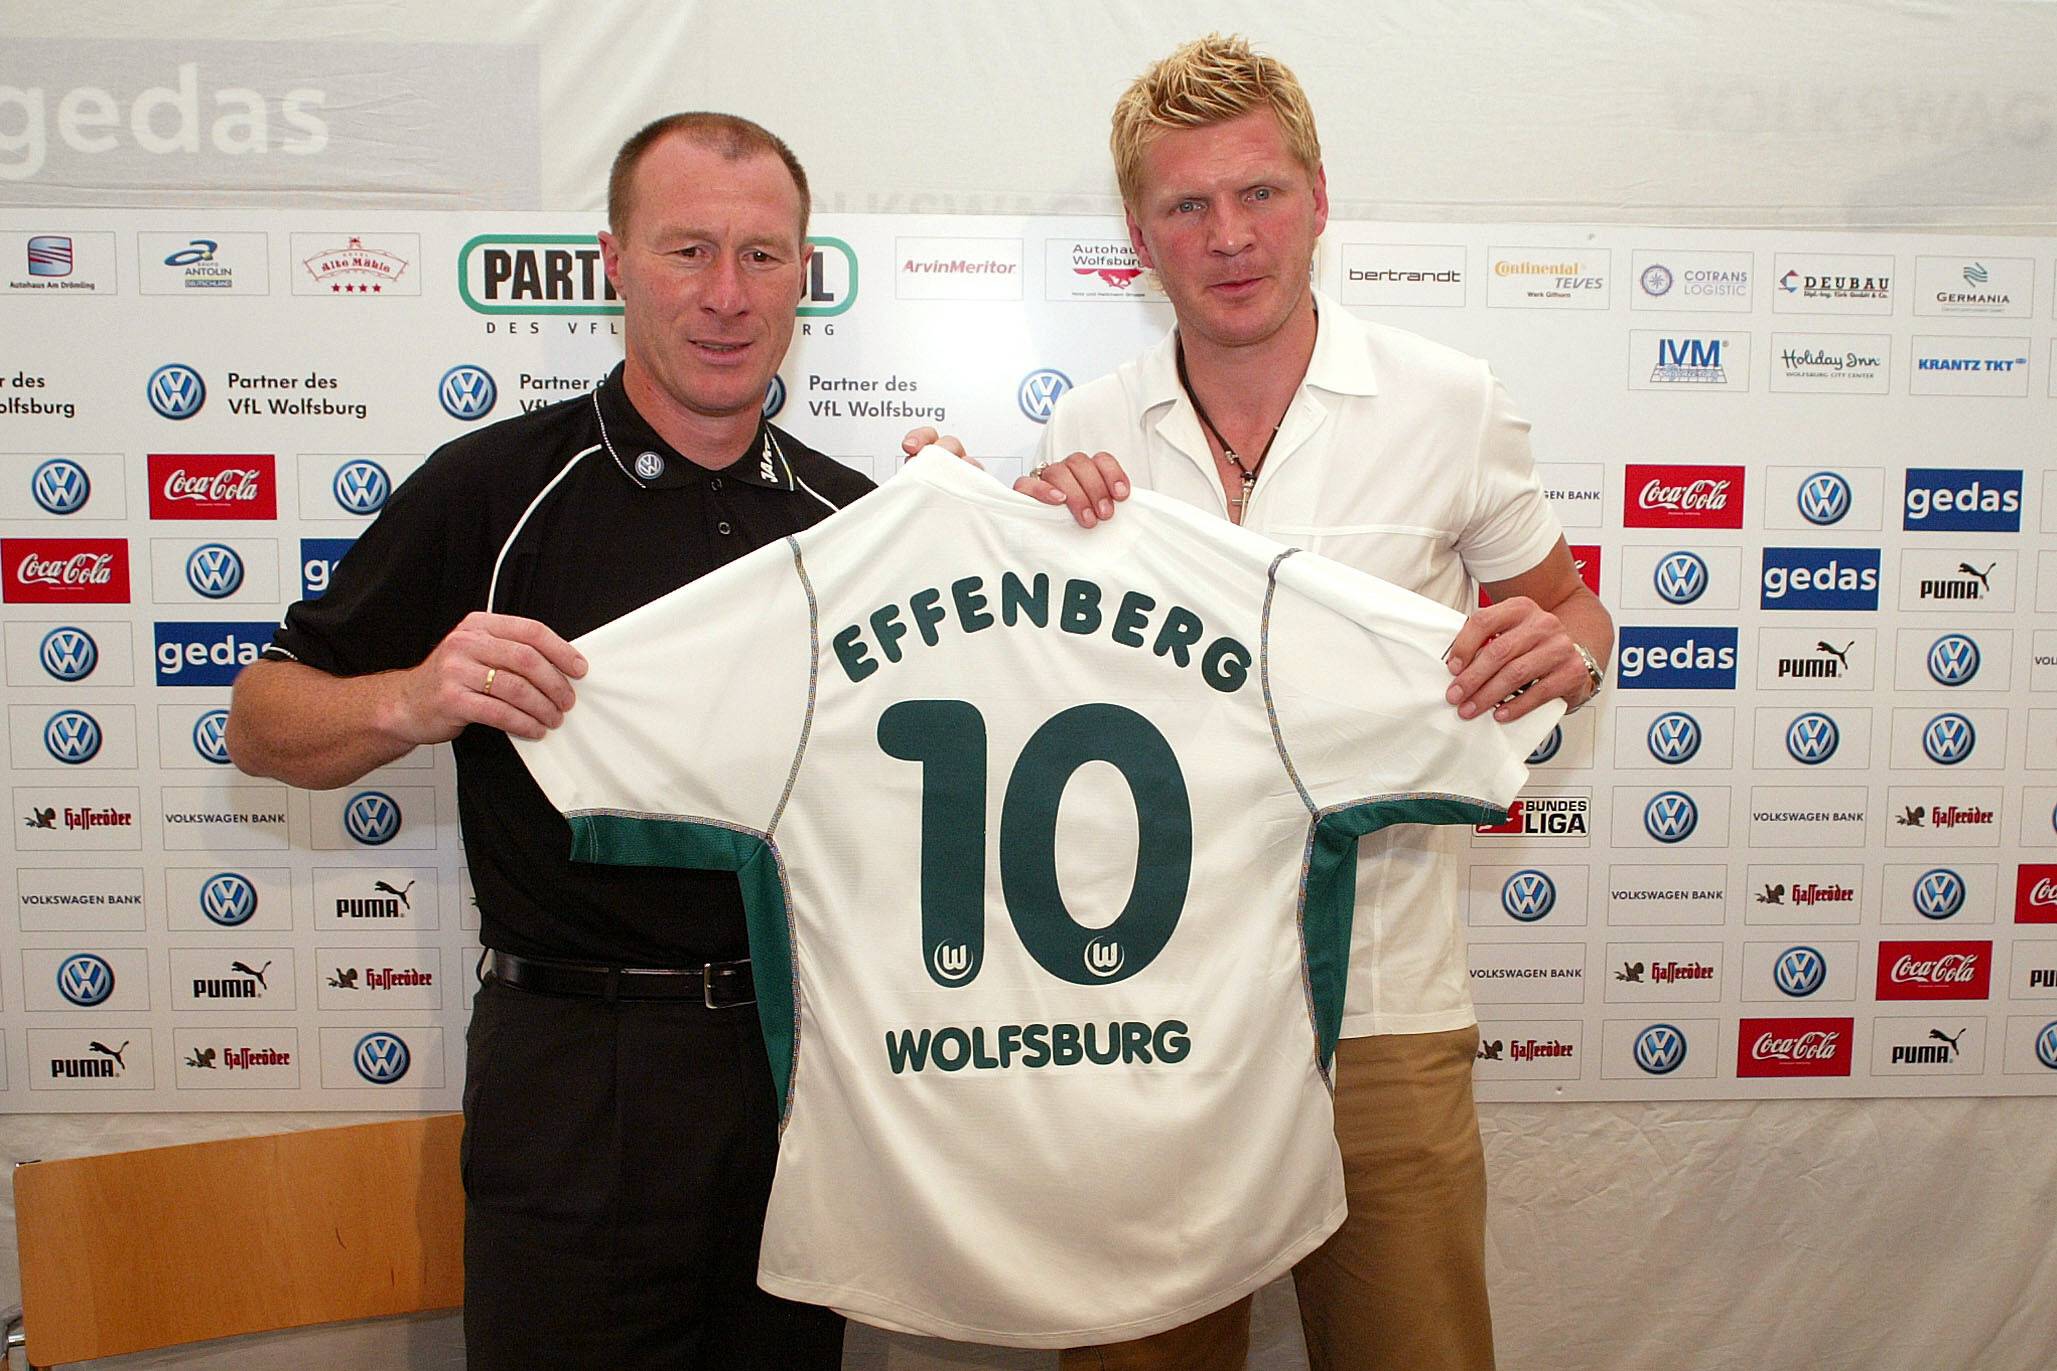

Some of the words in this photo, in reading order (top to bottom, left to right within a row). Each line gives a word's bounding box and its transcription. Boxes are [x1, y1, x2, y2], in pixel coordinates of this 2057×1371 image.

[0, 62, 330, 181] gedas
[1073, 244, 1136, 254] Autohau
[185, 268, 232, 276] ANTOLIN
[904, 260, 1016, 274] ArvinMeritor
[1350, 268, 1461, 282] bertrandt
[1494, 260, 1579, 277] Continental
[1555, 278, 1604, 289] TEVES
[1684, 270, 1748, 282] COTRANS
[1804, 276, 1889, 289] DEUBAU
[9, 281, 45, 289] Autohaus
[47, 281, 59, 289] Am
[1684, 284, 1747, 296] LOGISTIC
[487, 322, 539, 334] DES
[568, 322, 619, 335] VFL
[1659, 339, 1720, 367] IVM
[1781, 349, 1843, 370] Holiday
[1846, 352, 1880, 367] Inn
[1919, 359, 1981, 370] KRANTZ
[1984, 360, 2014, 371] TKT
[12, 371, 45, 388] des
[228, 373, 298, 388] Partner
[304, 372, 338, 388] des
[520, 374, 589, 389] Partner
[809, 375, 878, 391] Partner
[885, 375, 917, 391] des
[0, 397, 75, 418] olfsburg
[228, 398, 261, 414] VfL
[268, 398, 367, 419] Wolfsburg
[809, 400, 842, 416] VfL
[848, 401, 945, 421] Wolfsburg
[164, 469, 260, 500] Coca-Cola
[1568, 490, 1600, 499] BANK
[1639, 479, 1730, 510] Coca-Cola
[1907, 479, 2019, 518] gedas
[17, 553, 113, 584] Coca-Cola
[1764, 560, 1877, 598] gedas
[1920, 581, 1978, 598] PUMA
[833, 571, 1252, 693] EFFENBERG
[1621, 639, 1734, 677] gedas
[1779, 659, 1837, 677] PUMA
[1526, 801, 1587, 811] BUNDES
[166, 813, 248, 823] VOLKSWAGEN
[252, 814, 285, 823] BANK
[1525, 814, 1586, 833] LIGA
[1753, 812, 1829, 821] VOLKSWAGEN
[1833, 812, 1863, 821] BANK
[877, 699, 1193, 988] 10
[22, 895, 104, 904] VOLKSWAGEN
[108, 895, 141, 904] BANK
[1612, 890, 1688, 900] VOLKSWAGEN
[1692, 890, 1723, 900] BANK
[337, 900, 398, 917] PUMA
[1470, 969, 1547, 978] VOLKSWAGEN
[1551, 969, 1582, 978] BANK
[1891, 954, 1977, 982] Coca-Cola
[194, 980, 255, 998] PUMA
[886, 1020, 1191, 1074] WOLFSBURG
[1752, 1031, 1839, 1060] Coca-Cola
[1892, 1046, 1949, 1063] PUMA
[52, 1060, 114, 1077] PUMA
